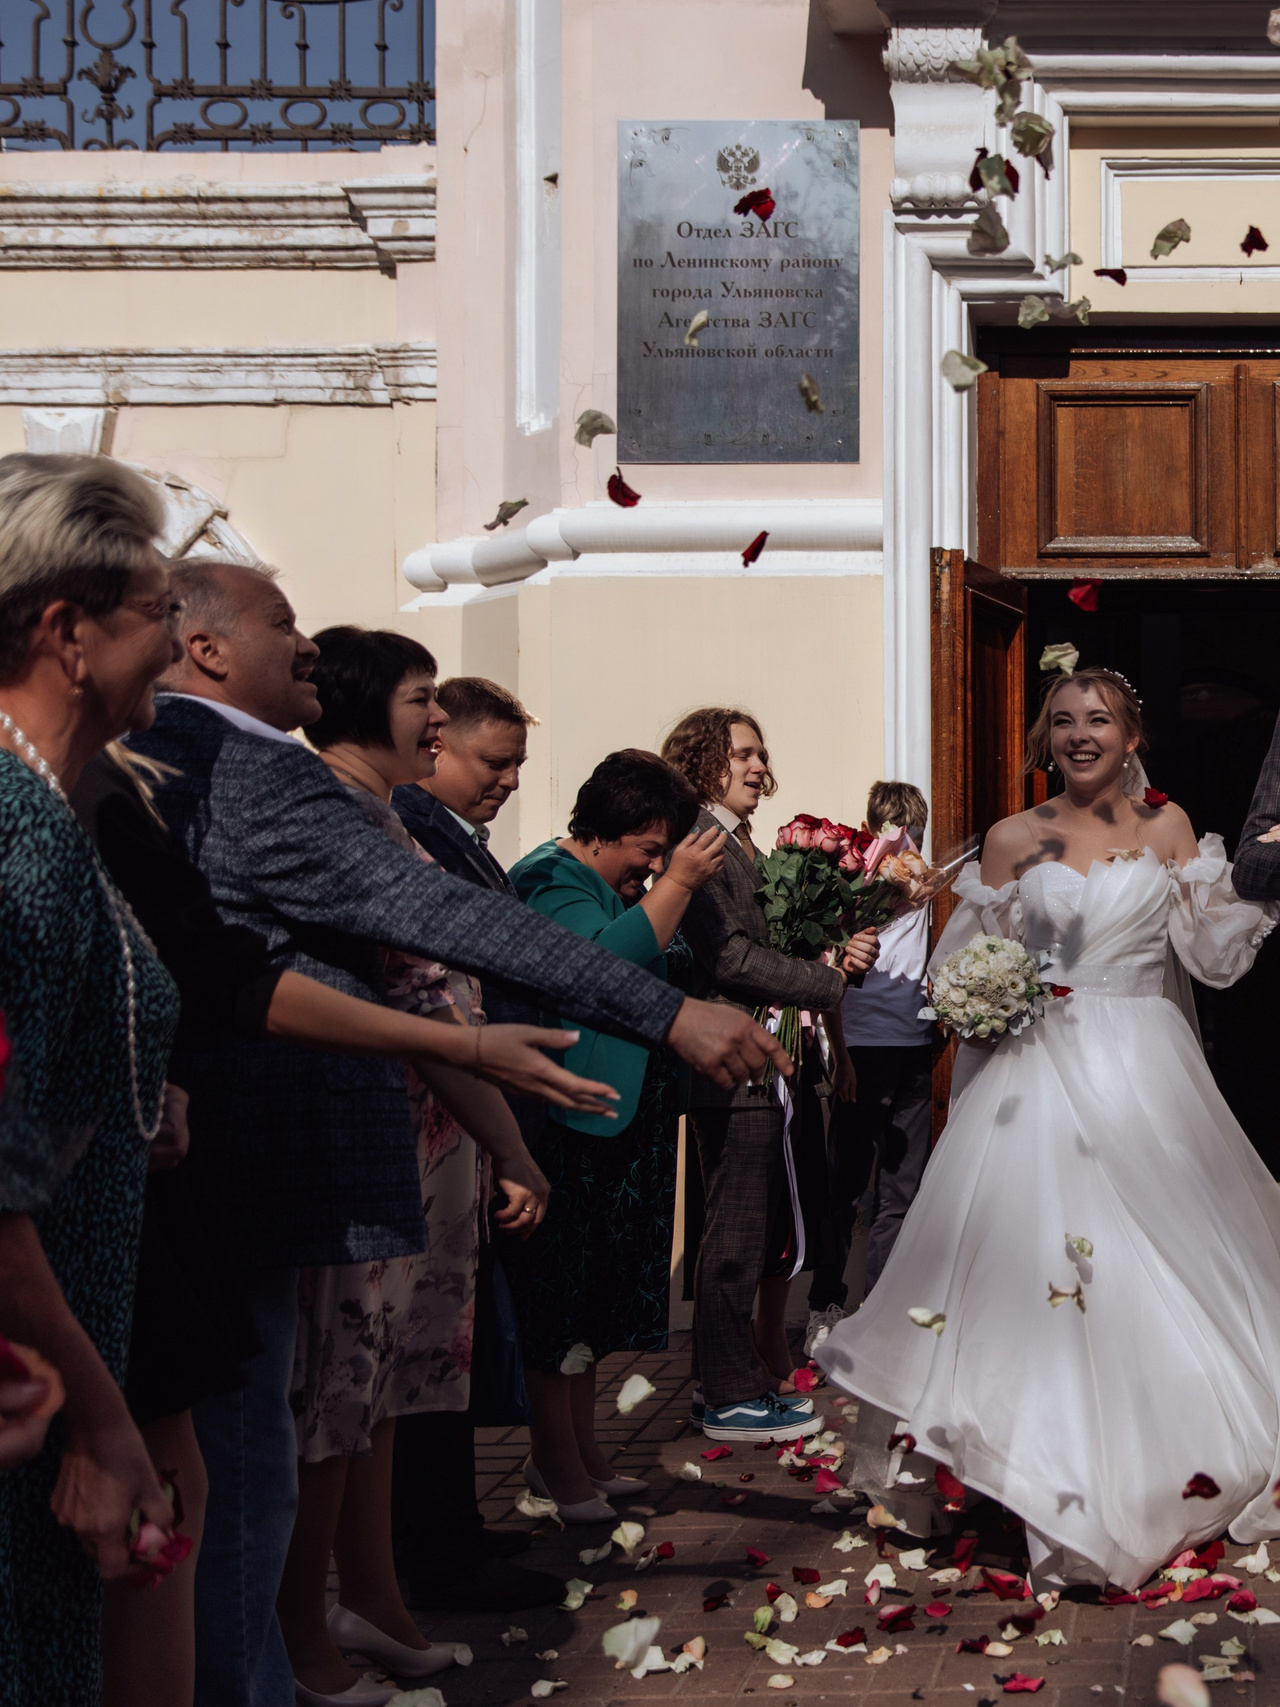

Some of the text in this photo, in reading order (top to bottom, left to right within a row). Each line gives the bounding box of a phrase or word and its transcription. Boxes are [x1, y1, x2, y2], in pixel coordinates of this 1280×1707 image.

[676, 221, 799, 241] Отдел ЗАГС
[632, 251, 843, 273] по Ленинскому району
[652, 281, 824, 302] города Ульяновска
[657, 311, 817, 329] Агетства ЗАГС
[642, 341, 834, 359] Ульяновской области
